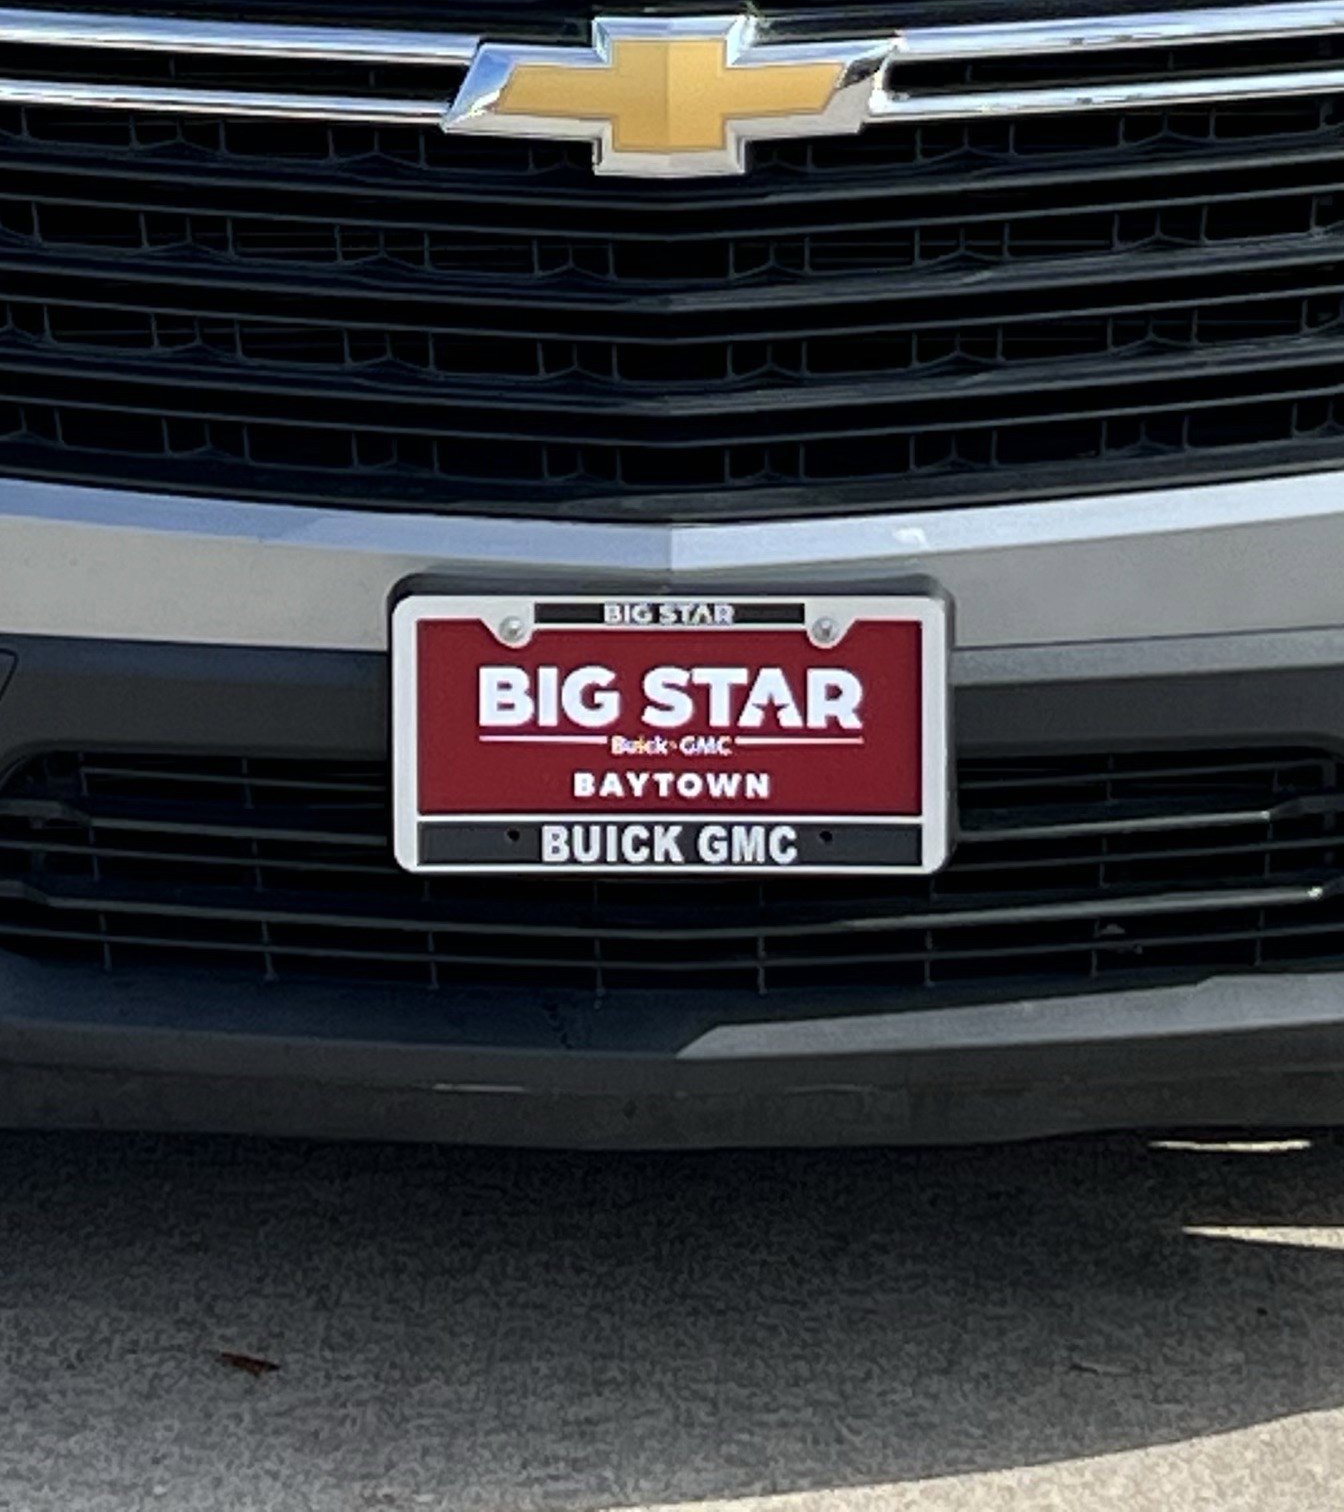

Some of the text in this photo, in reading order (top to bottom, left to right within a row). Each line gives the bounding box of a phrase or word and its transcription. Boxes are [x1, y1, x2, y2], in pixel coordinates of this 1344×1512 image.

[604, 603, 735, 624] BIG STAR
[478, 665, 864, 730] BIG STAR
[678, 735, 734, 757] GMC
[573, 771, 770, 799] BAYTOWN
[541, 824, 798, 865] BUICK GMC
